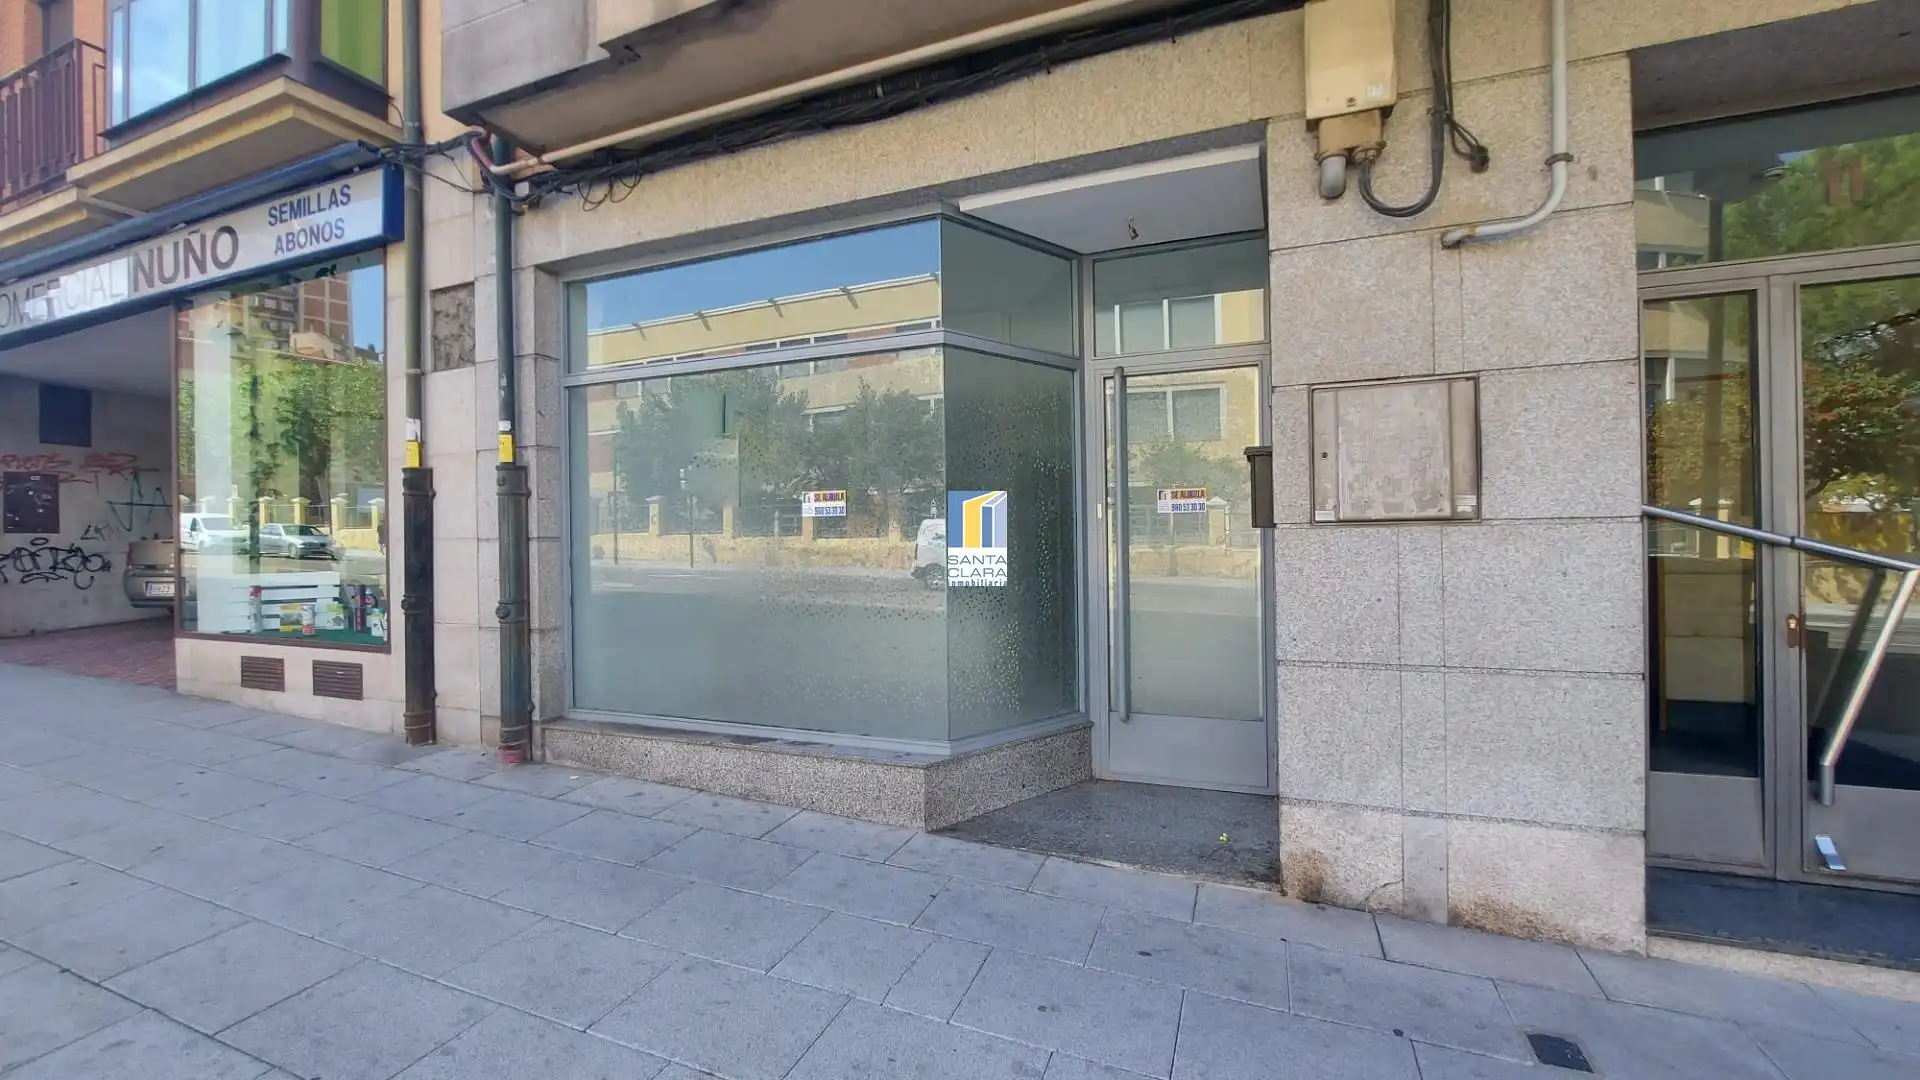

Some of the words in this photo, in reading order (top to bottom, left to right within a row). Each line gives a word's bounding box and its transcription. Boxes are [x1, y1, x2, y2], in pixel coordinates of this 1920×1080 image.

[268, 184, 351, 226] SEMILLAS
[274, 217, 345, 256] ABONOS
[133, 225, 239, 293] NUÑO
